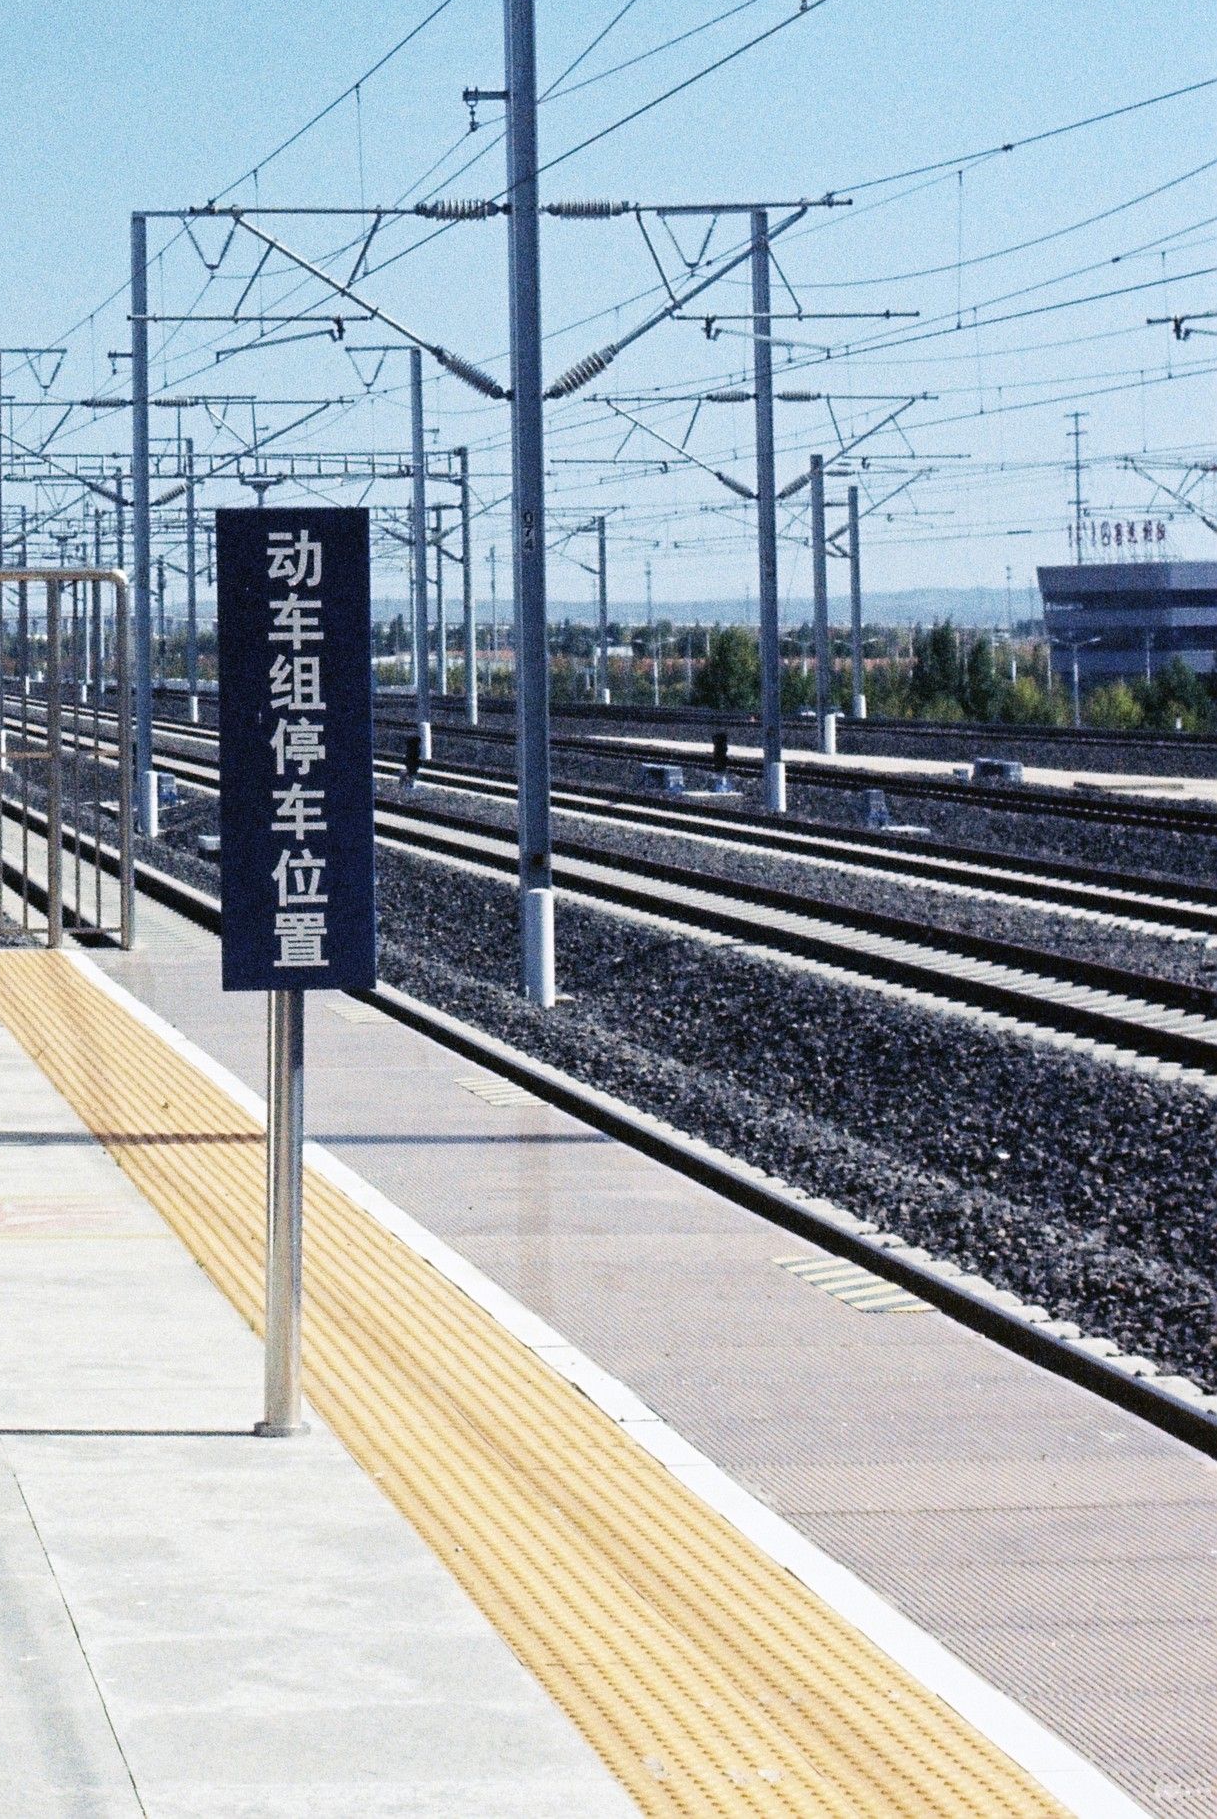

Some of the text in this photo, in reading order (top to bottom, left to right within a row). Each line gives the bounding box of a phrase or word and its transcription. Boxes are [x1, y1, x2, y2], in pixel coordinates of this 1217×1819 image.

[266, 529, 330, 968] 动车组停车位置
